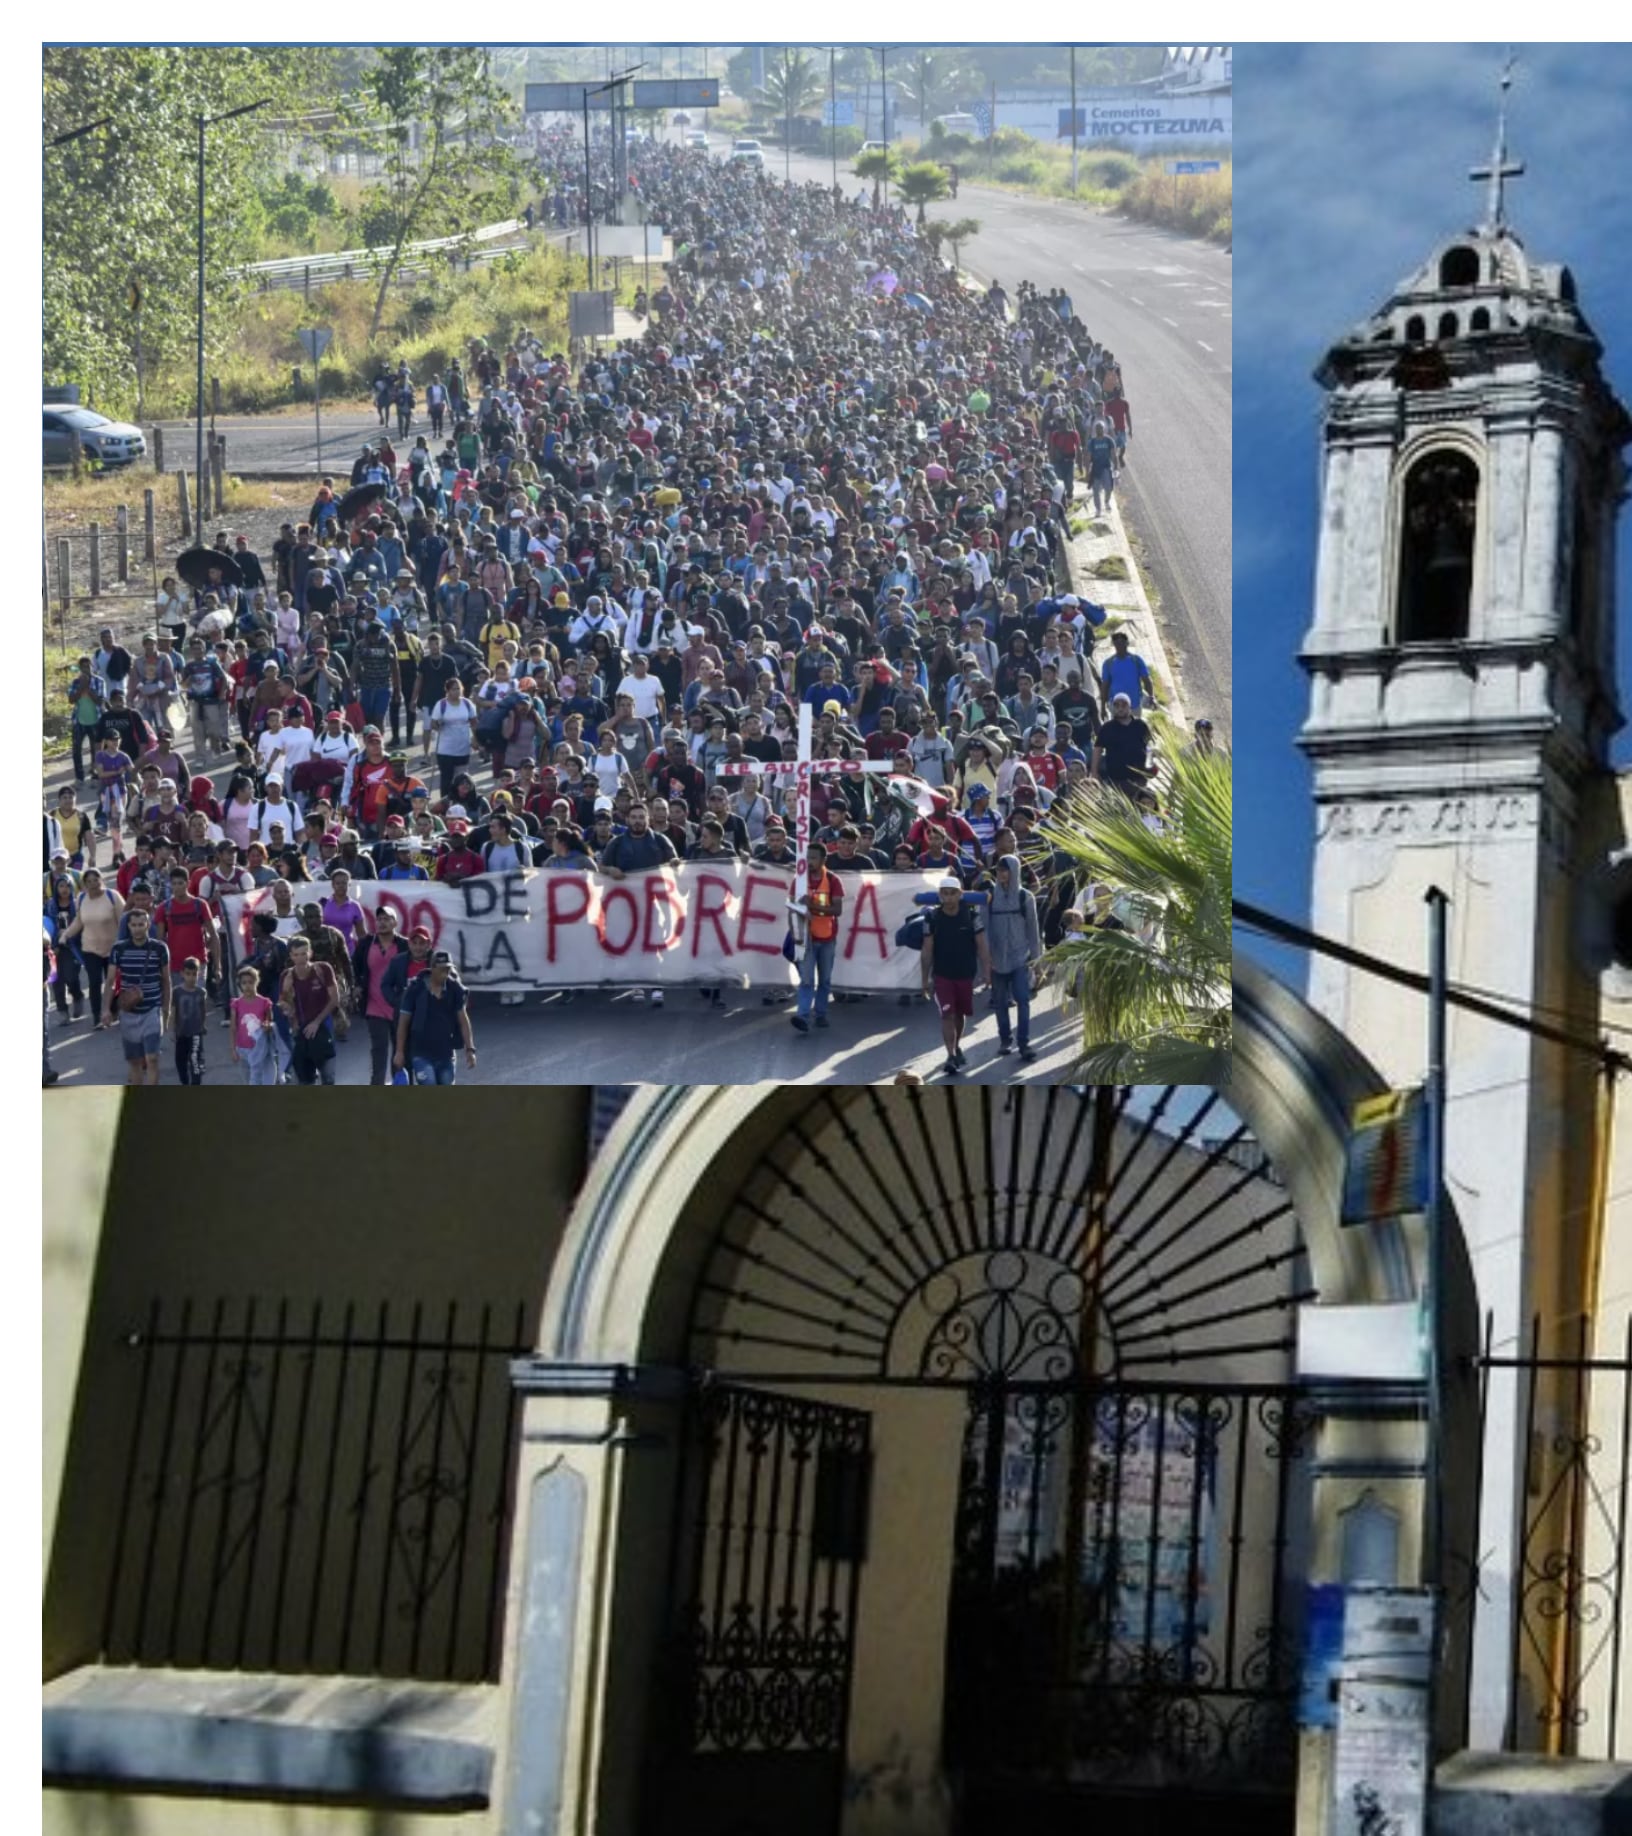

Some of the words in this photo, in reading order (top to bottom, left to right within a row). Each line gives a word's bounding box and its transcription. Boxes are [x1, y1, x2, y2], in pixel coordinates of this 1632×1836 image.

[1092, 107, 1161, 118] Cementos
[1092, 118, 1224, 136] MOCTEZUMA
[462, 874, 530, 918] DE
[547, 875, 888, 963] POBREA
[458, 930, 521, 973] LA
